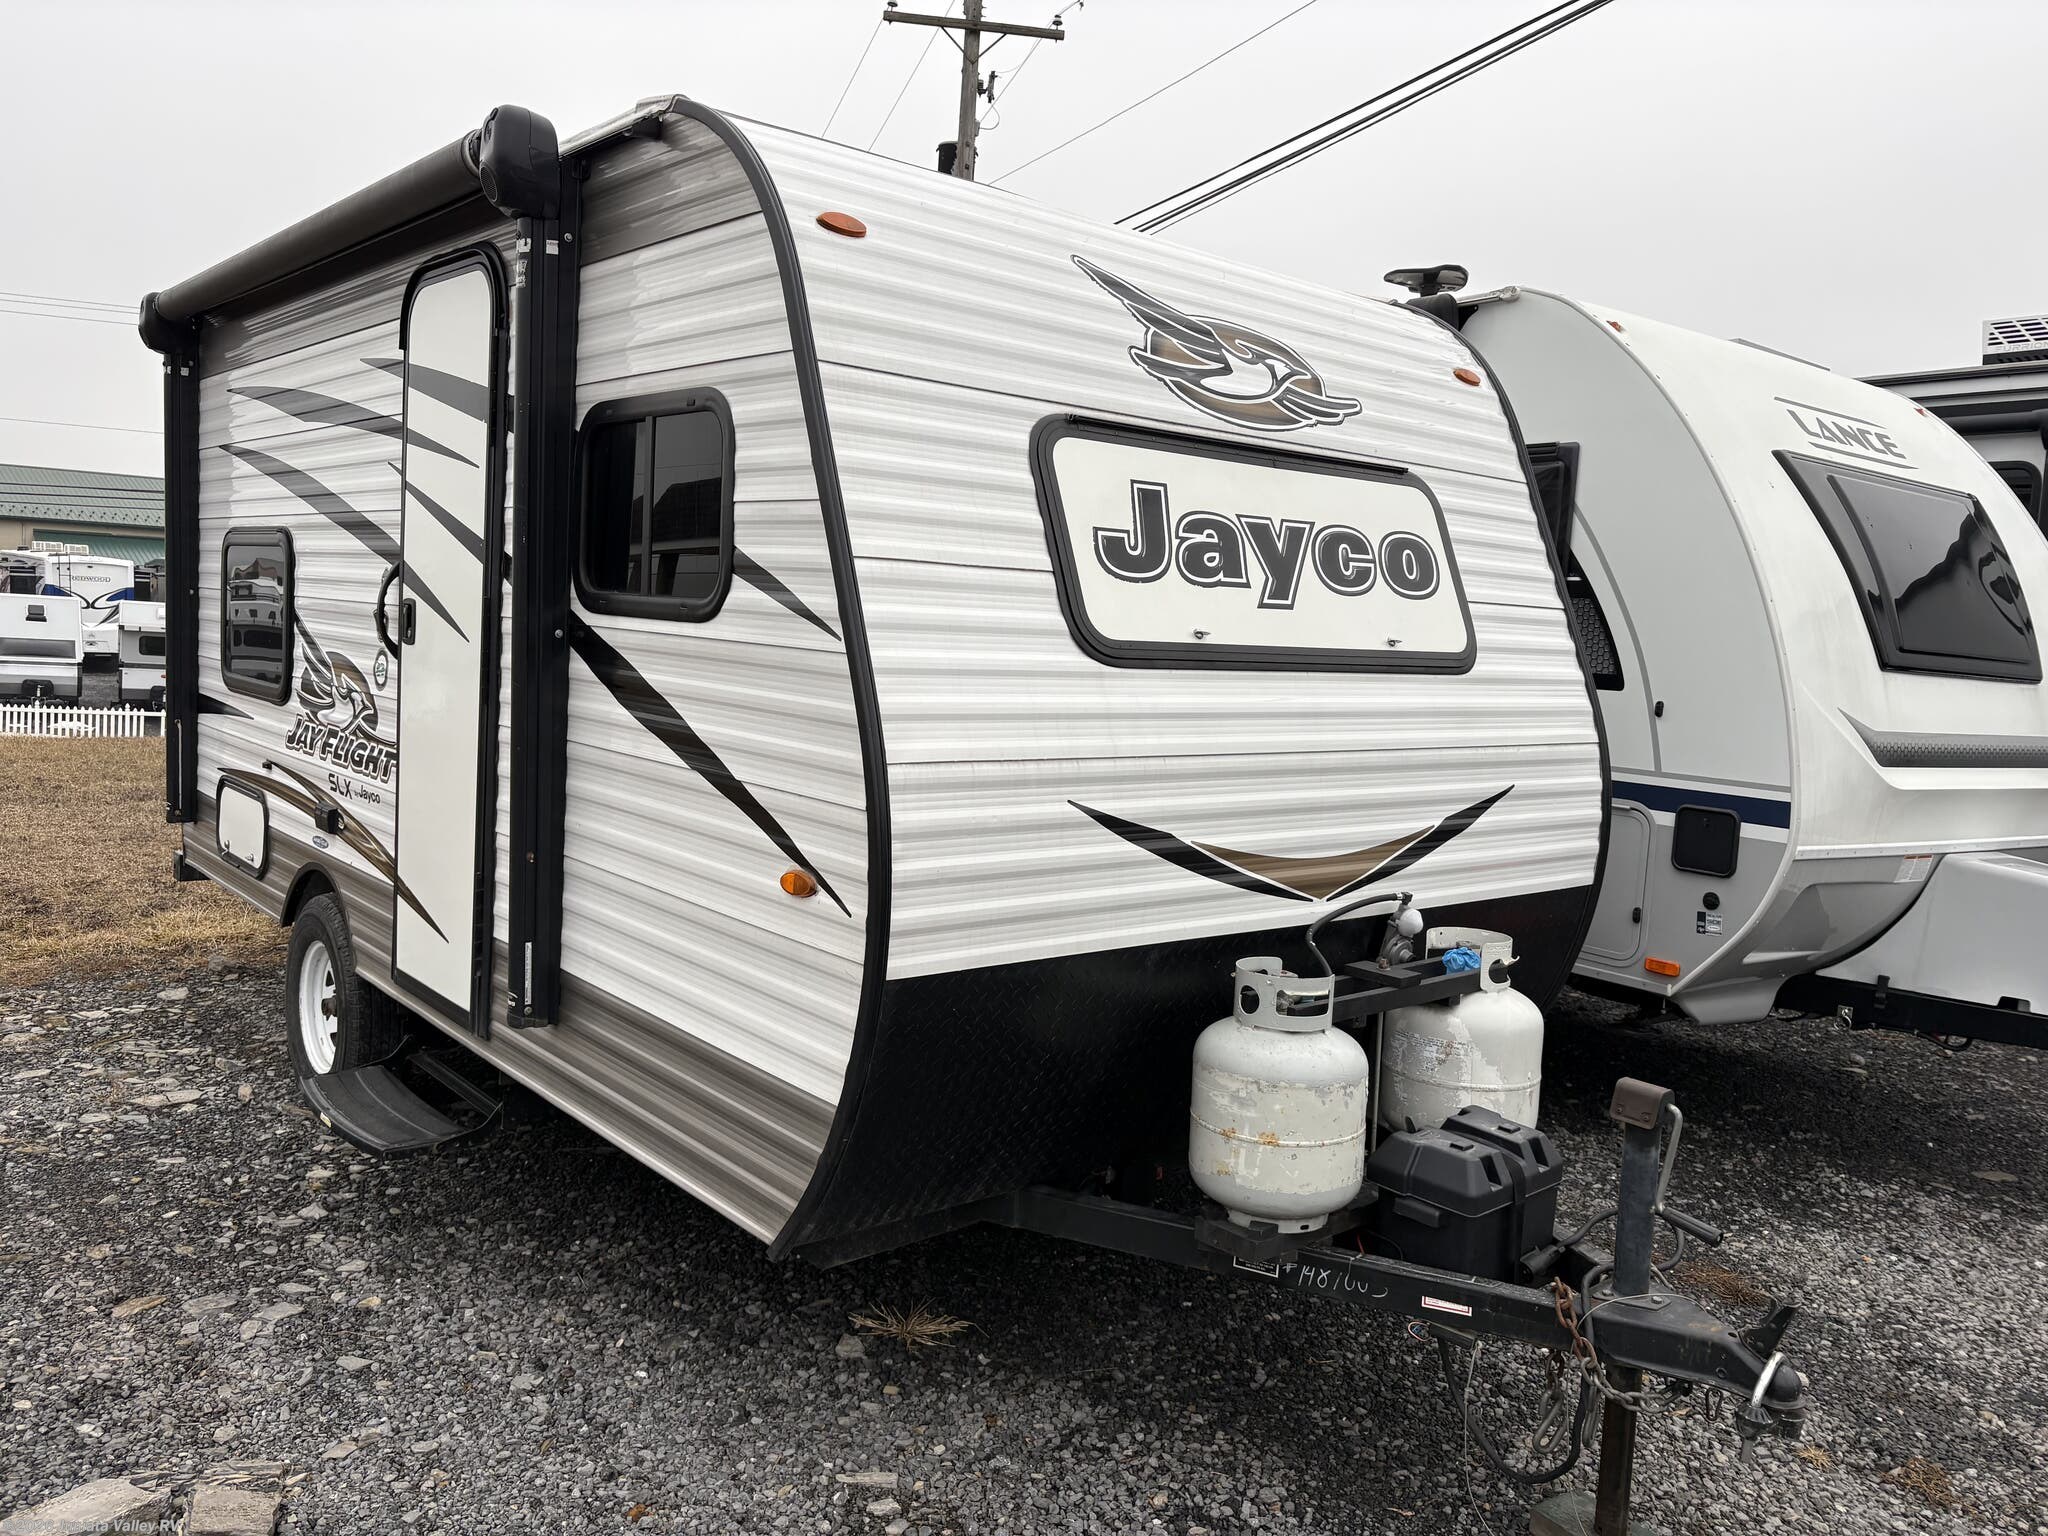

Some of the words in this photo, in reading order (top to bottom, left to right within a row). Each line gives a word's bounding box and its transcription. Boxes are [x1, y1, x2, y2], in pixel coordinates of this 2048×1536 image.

[1786, 408, 1907, 459] LANCE
[1092, 479, 1440, 610] Jayco
[285, 713, 323, 757] JAY
[319, 723, 398, 784] FLIGHT
[328, 772, 353, 800] SLX
[360, 784, 381, 804] Jayco
